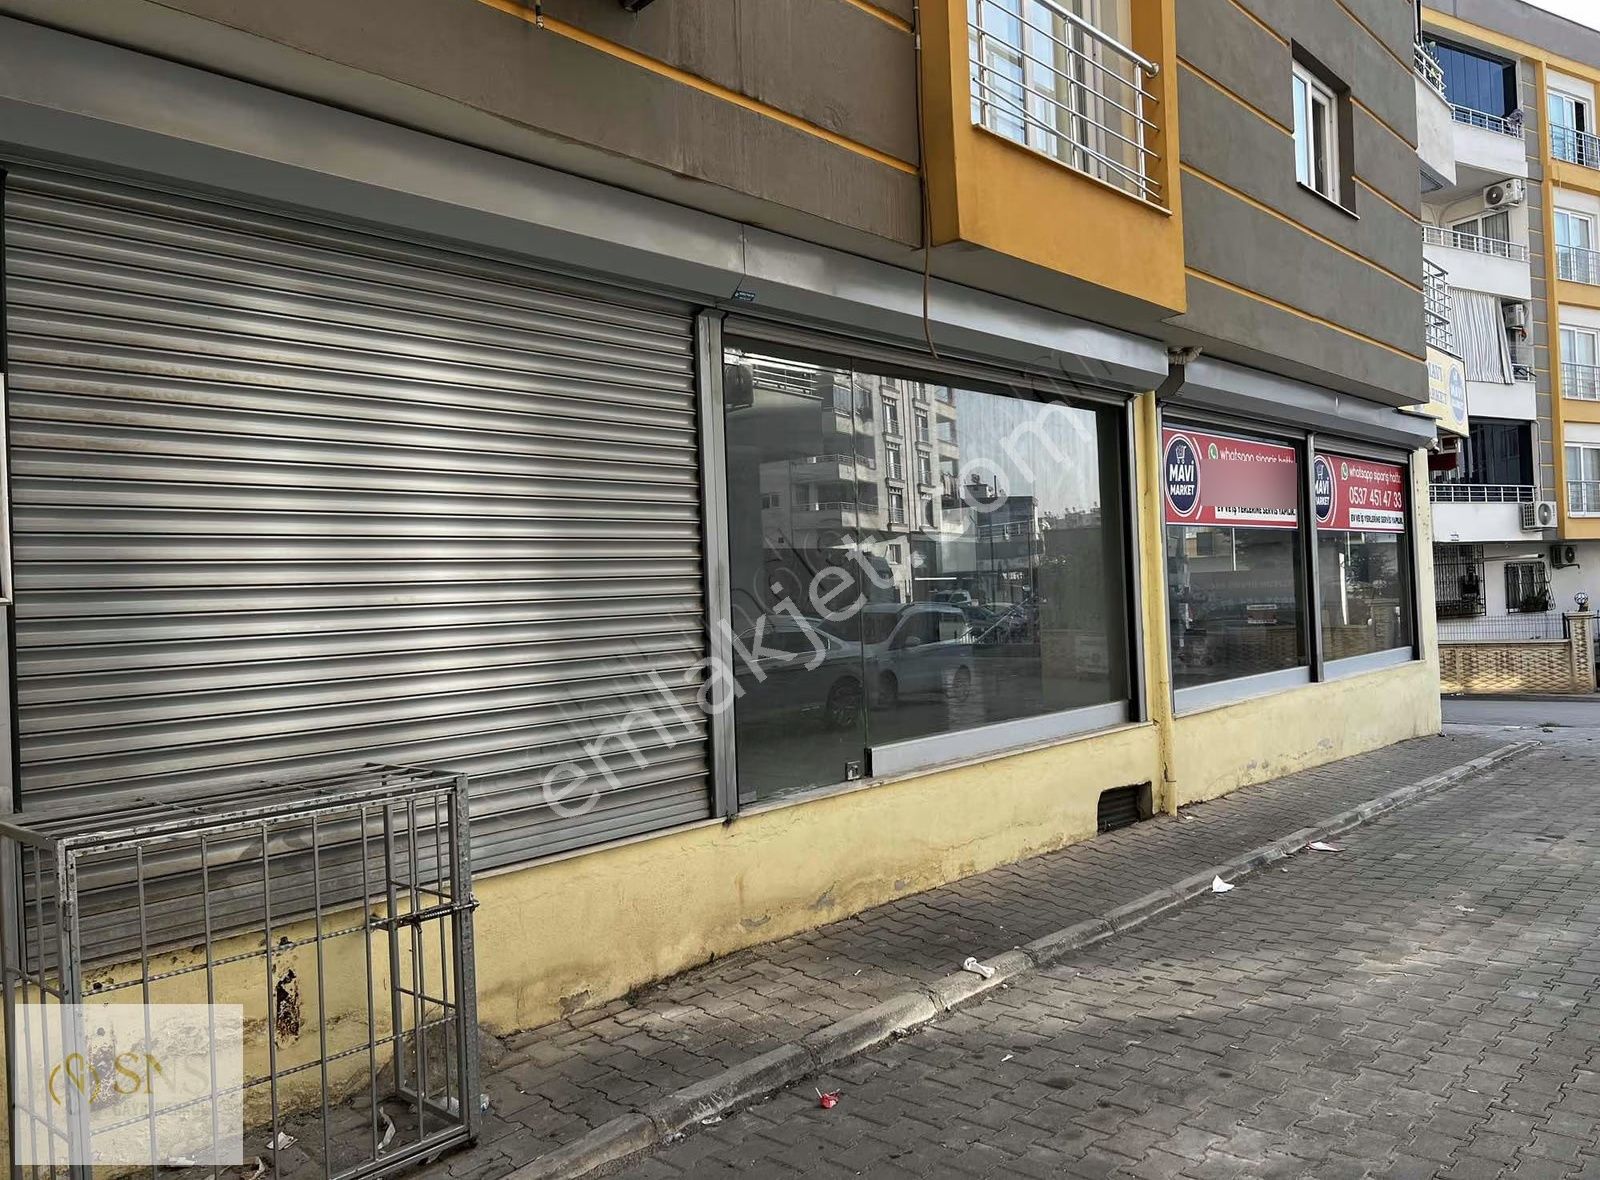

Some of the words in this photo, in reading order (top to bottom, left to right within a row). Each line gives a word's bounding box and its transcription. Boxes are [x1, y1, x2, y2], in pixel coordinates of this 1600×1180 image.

[1169, 460, 1194, 482] MAVİ
[1170, 485, 1195, 496] MARKET
[1349, 486, 1367, 505] 0537
[1369, 489, 1382, 507] 451
[1383, 490, 1392, 507] 47
[1393, 492, 1403, 509] 33
